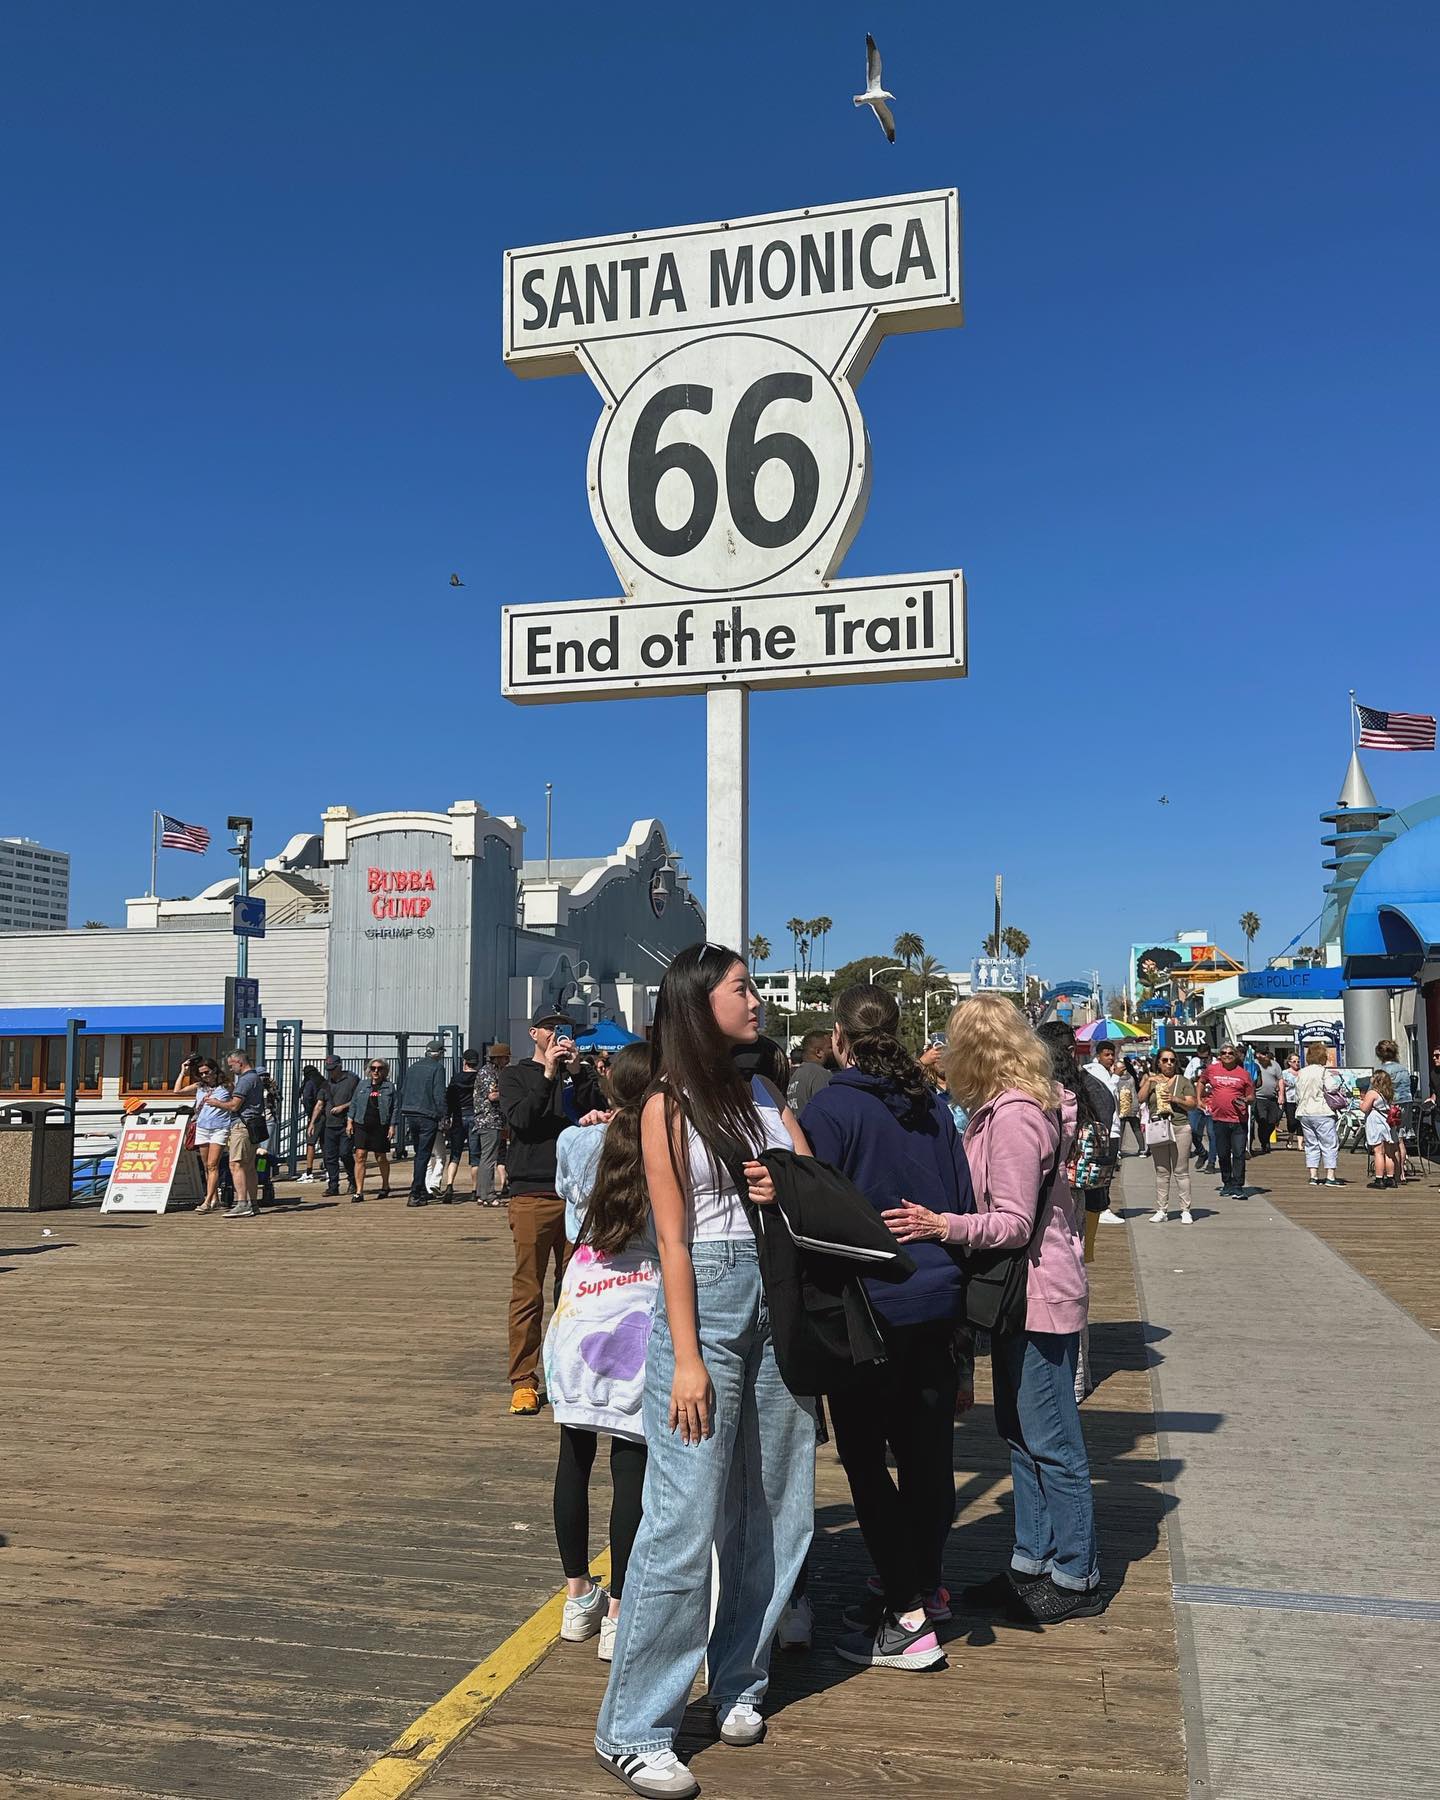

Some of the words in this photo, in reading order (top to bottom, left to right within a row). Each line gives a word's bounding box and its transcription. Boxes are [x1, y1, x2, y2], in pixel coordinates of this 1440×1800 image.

[521, 252, 688, 331] SANTA
[709, 217, 937, 309] MONICA
[627, 371, 820, 558] 66
[526, 615, 619, 676] End
[640, 609, 694, 668] of
[712, 605, 796, 664] the
[815, 590, 934, 656] Trail
[368, 868, 436, 892] BUBBA
[372, 895, 432, 921] GUMP
[1266, 974, 1310, 988] POLICE
[1174, 1029, 1207, 1046] BAR
[125, 1141, 161, 1151] SEE
[120, 1161, 156, 1171] SAY
[575, 1270, 653, 1298] Supreme
